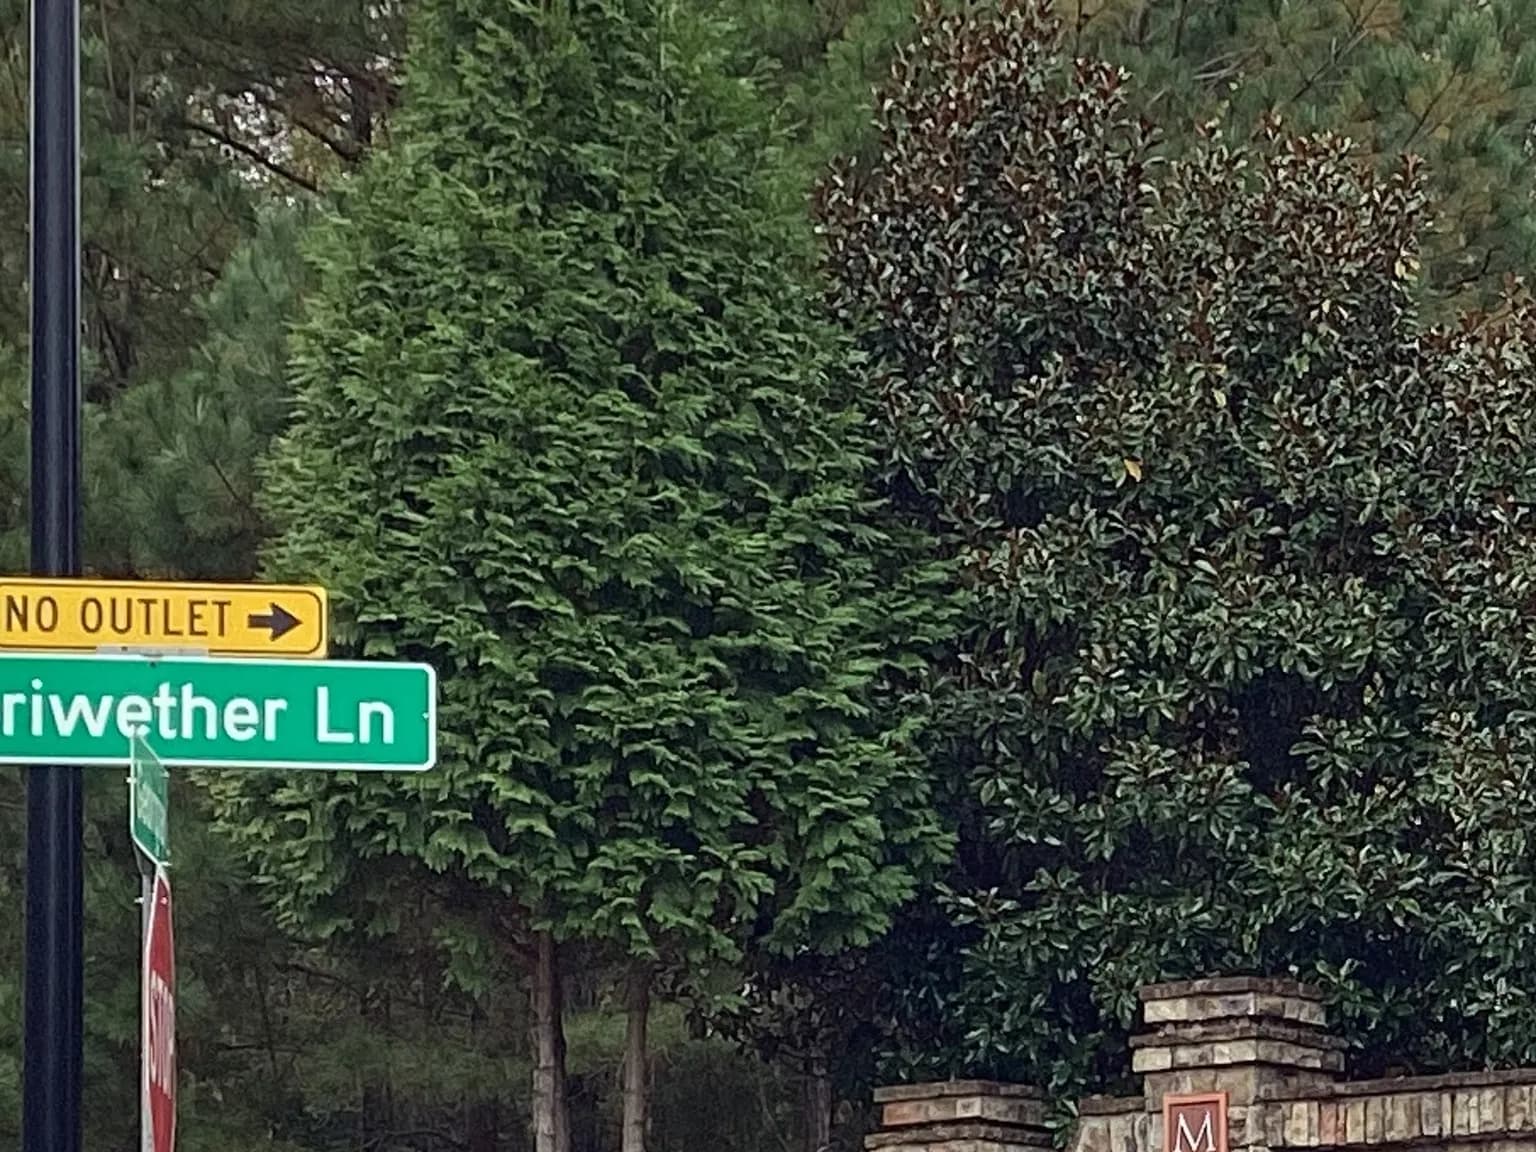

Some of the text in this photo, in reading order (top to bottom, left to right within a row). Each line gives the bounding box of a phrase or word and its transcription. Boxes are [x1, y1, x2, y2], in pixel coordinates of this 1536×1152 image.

[6, 595, 231, 637] NO OUTLET
[2, 678, 395, 744] riwether Ln
